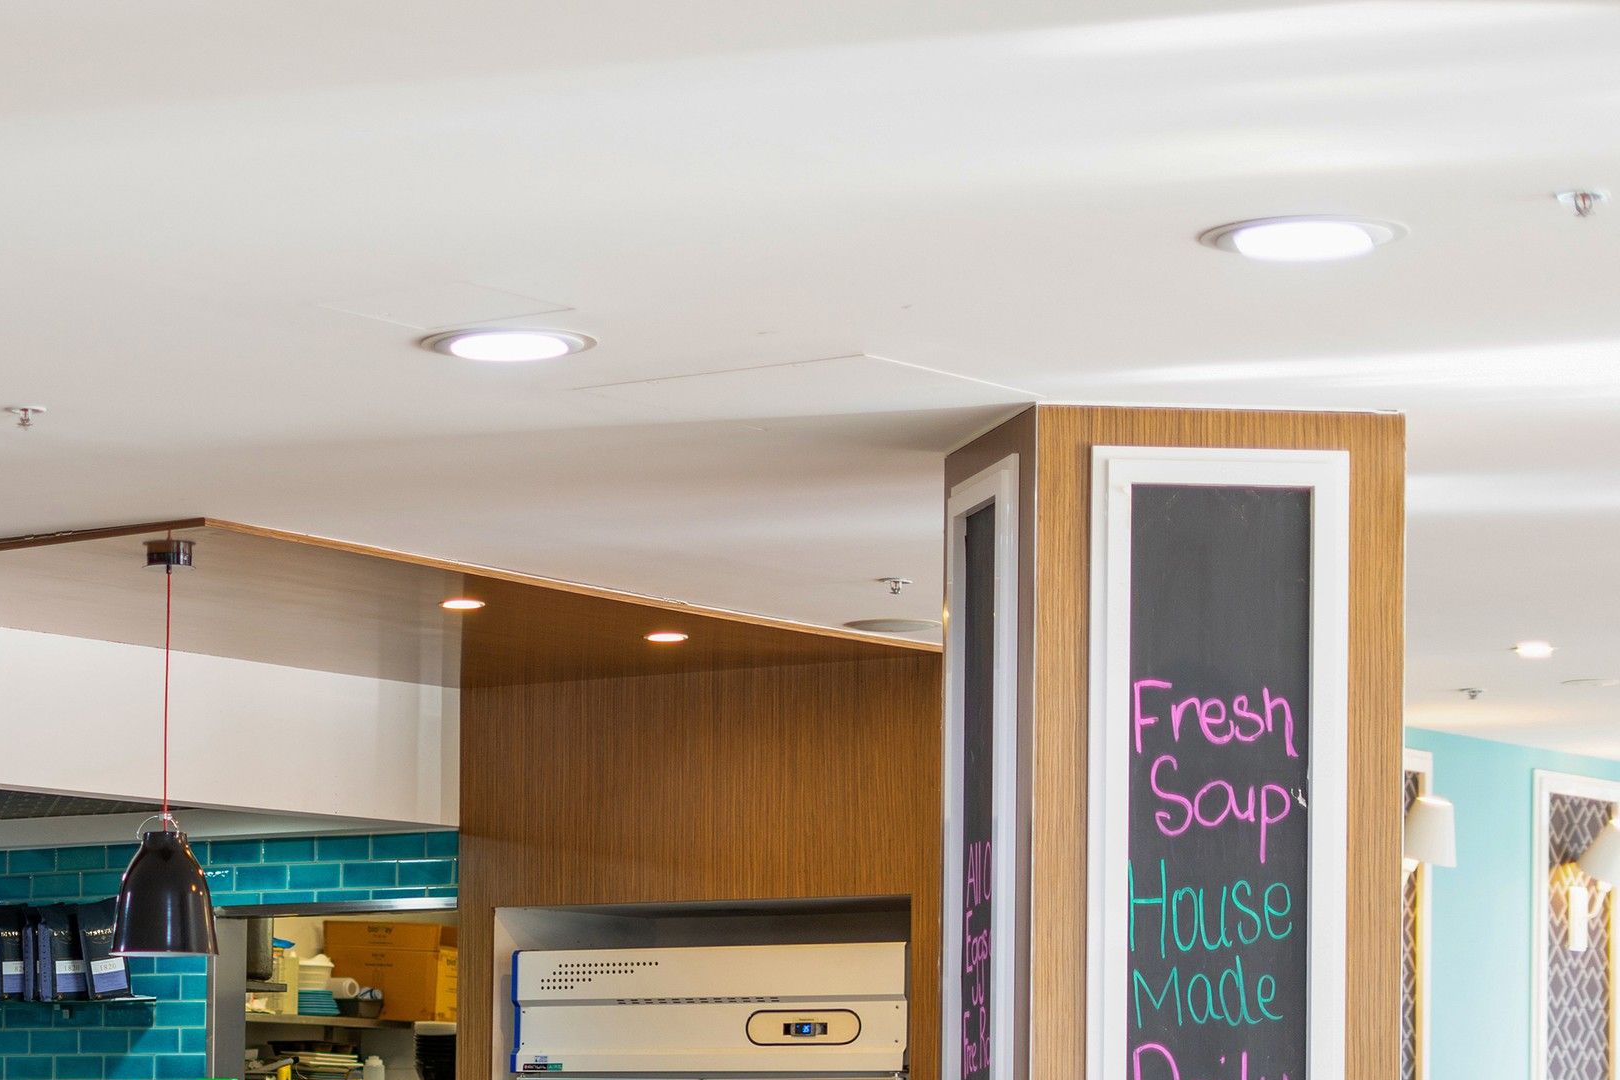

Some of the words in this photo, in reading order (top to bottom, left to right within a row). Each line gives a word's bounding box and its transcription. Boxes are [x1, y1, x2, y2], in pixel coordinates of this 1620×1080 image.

[1133, 679, 1299, 758] Fresh
[1127, 858, 1293, 959] House
[966, 910, 988, 1006] Eggs
[1132, 954, 1284, 1028] Made
[963, 1010, 978, 1080] Free
